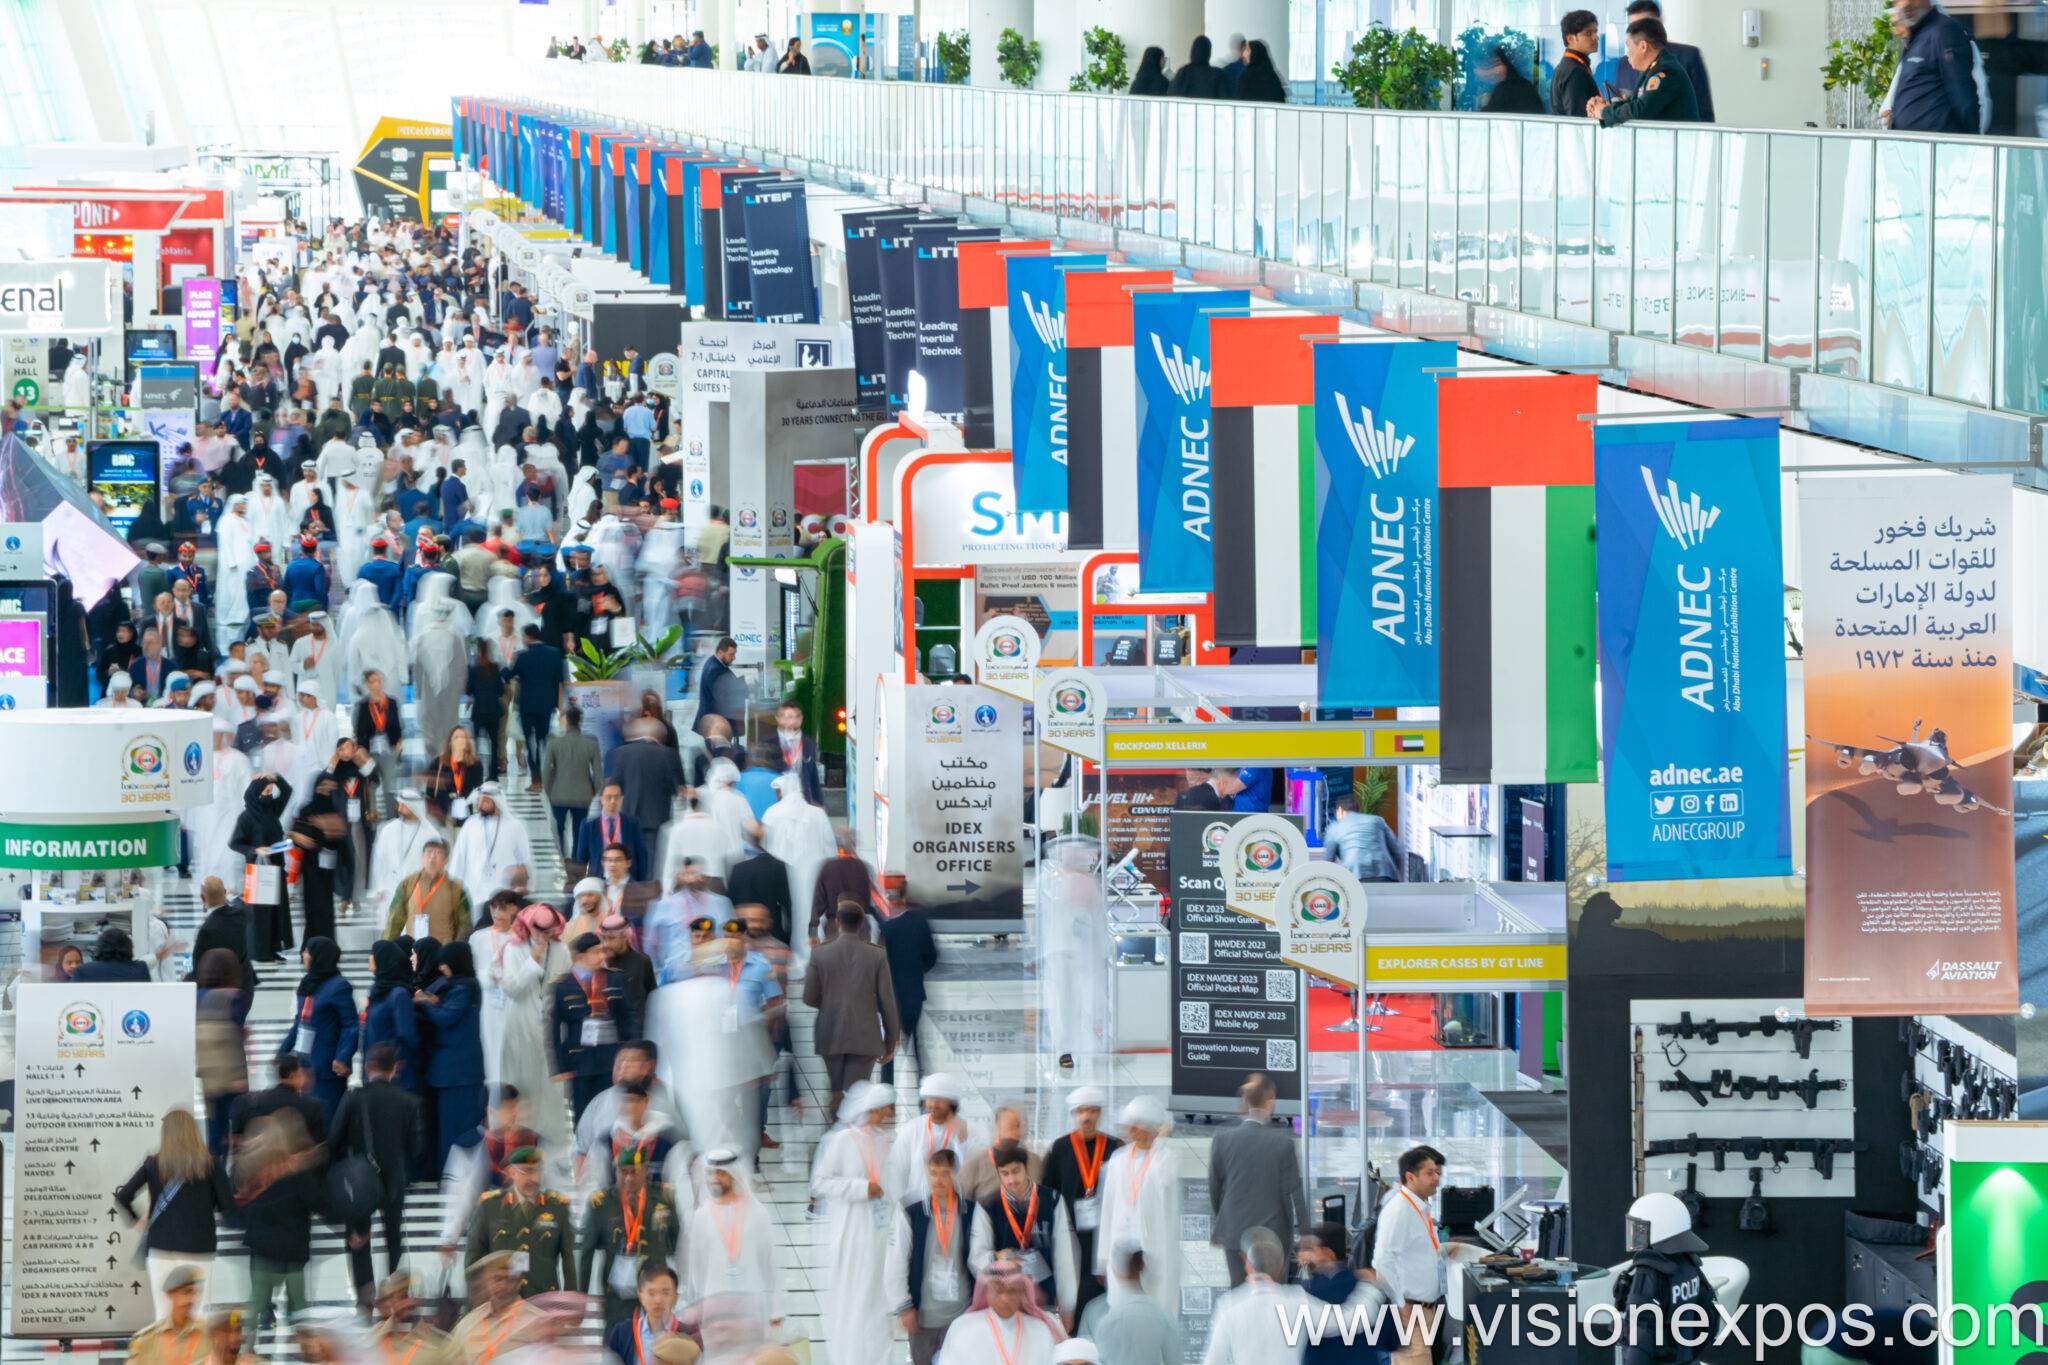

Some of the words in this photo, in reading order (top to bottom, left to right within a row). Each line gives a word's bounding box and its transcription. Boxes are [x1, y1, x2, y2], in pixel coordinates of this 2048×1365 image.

[745, 192, 792, 205] LITEF
[750, 248, 779, 257] Leading
[751, 258, 777, 266] Inertial
[752, 265, 793, 275] Technology
[919, 321, 958, 331] Leading
[920, 334, 954, 343] Inertial
[14, 368, 38, 376] HALL
[697, 369, 730, 379] CAPITAL
[693, 384, 720, 393] SUITES
[791, 415, 813, 426] YEARS
[1181, 416, 1211, 542] ADNEC
[1422, 498, 1431, 525] Centre
[1874, 515, 1926, 544] فخور
[1935, 515, 1996, 541] شريك
[962, 543, 1022, 552] PROTECTING
[1423, 526, 1432, 566] Exhibition
[1830, 548, 1920, 572] المسلحة
[1928, 547, 1996, 574] للقوات
[1370, 493, 1406, 646] ADNEC
[1423, 567, 1432, 602] National
[1729, 568, 1738, 593] Centre
[1856, 581, 1936, 610] الإمارات
[1944, 580, 1996, 608] لدولة
[1423, 603, 1432, 628] Dhabi
[1729, 594, 1739, 634] Exhibition
[1835, 614, 1917, 637] المتحدة
[1925, 612, 1996, 640] العربية
[734, 634, 762, 643] ADNEC
[1424, 629, 1433, 645] Abu
[1677, 564, 1715, 712] ADNEC
[1730, 635, 1740, 669] National
[1912, 649, 1953, 668] سنة
[1961, 649, 1997, 667] منذ
[1856, 649, 1904, 669] ١٩٧٢
[1731, 670, 1740, 695] Dhabi
[1732, 695, 1741, 712] Abu
[1062, 729, 1096, 737] YEARS
[1114, 742, 1164, 750] ROCKFORD
[1166, 742, 1208, 750] XELLERIX
[940, 756, 988, 771] مكتب
[1650, 763, 1743, 786] adnec.ae
[932, 776, 996, 791] منظمين
[946, 822, 982, 834] IDEX
[1652, 820, 1745, 842] ADNECGROUP
[5, 838, 147, 858] INFORMATION
[913, 841, 1016, 853] ORGANISERS
[936, 860, 992, 872] OFFICE
[1179, 876, 1211, 890] Scan
[1186, 904, 1204, 913] IDEX
[1206, 904, 1225, 913] 2023
[1186, 914, 1214, 922] Official
[1214, 914, 1236, 923] Show
[1214, 940, 1246, 949] NAVDEX
[1248, 941, 1266, 949] 2023
[1290, 944, 1307, 953] 30
[1310, 944, 1352, 953] YEARS
[1214, 948, 1241, 958] Official
[1242, 950, 1263, 958] Show
[1378, 958, 1438, 971] EXPLORER
[1441, 958, 1478, 970] CASES
[1481, 958, 1496, 969] BY
[1498, 957, 1514, 969] GT
[1517, 957, 1544, 969] LINE
[1942, 961, 2002, 971] DASSAULT
[1187, 974, 1204, 982] IDEX
[1206, 974, 1238, 983] NAVDEX
[1239, 975, 1258, 983] 2023
[1940, 971, 1997, 980] AVIATION
[1187, 982, 1214, 992] Official
[1215, 983, 1242, 992] Pocket
[1243, 985, 1259, 995] Map
[1215, 1009, 1232, 1018] IDEX
[1234, 1010, 1266, 1019] NAVDEX
[1267, 1011, 1286, 1020] 2023
[1215, 1019, 1241, 1028] Mobile
[1243, 1021, 1259, 1031] App
[1187, 1043, 1228, 1052] Innovation
[1229, 1044, 1260, 1056] Journey
[1187, 1052, 1211, 1062] Guide
[21, 1316, 40, 1324] IDEX
